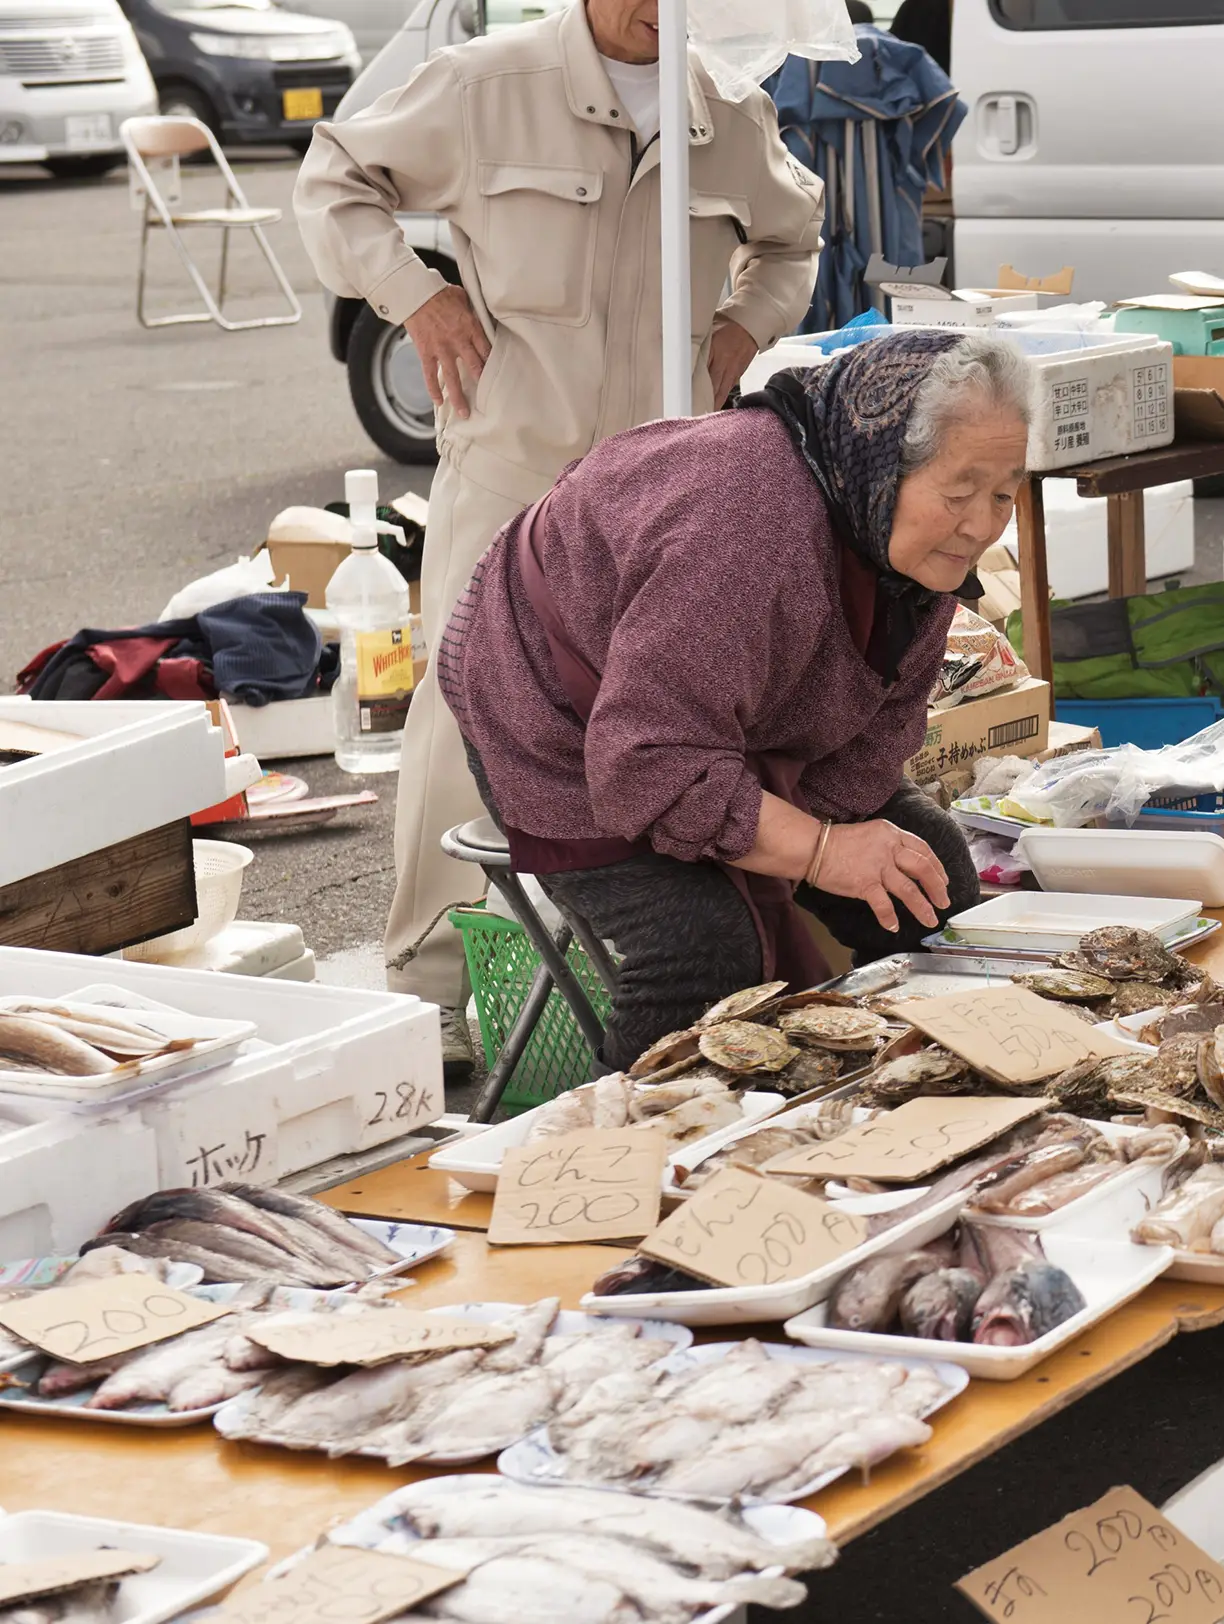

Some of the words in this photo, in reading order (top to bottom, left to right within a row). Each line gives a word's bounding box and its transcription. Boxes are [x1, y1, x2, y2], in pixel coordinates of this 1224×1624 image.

[1136, 405, 1143, 418] 11
[1149, 403, 1155, 415] 12
[1158, 401, 1165, 413] 13
[1149, 420, 1155, 432] 15
[1054, 435, 1075, 451] チリ産
[186, 1130, 267, 1188] ホッケ
[520, 1191, 640, 1230] 200
[44, 1293, 188, 1355] 200
